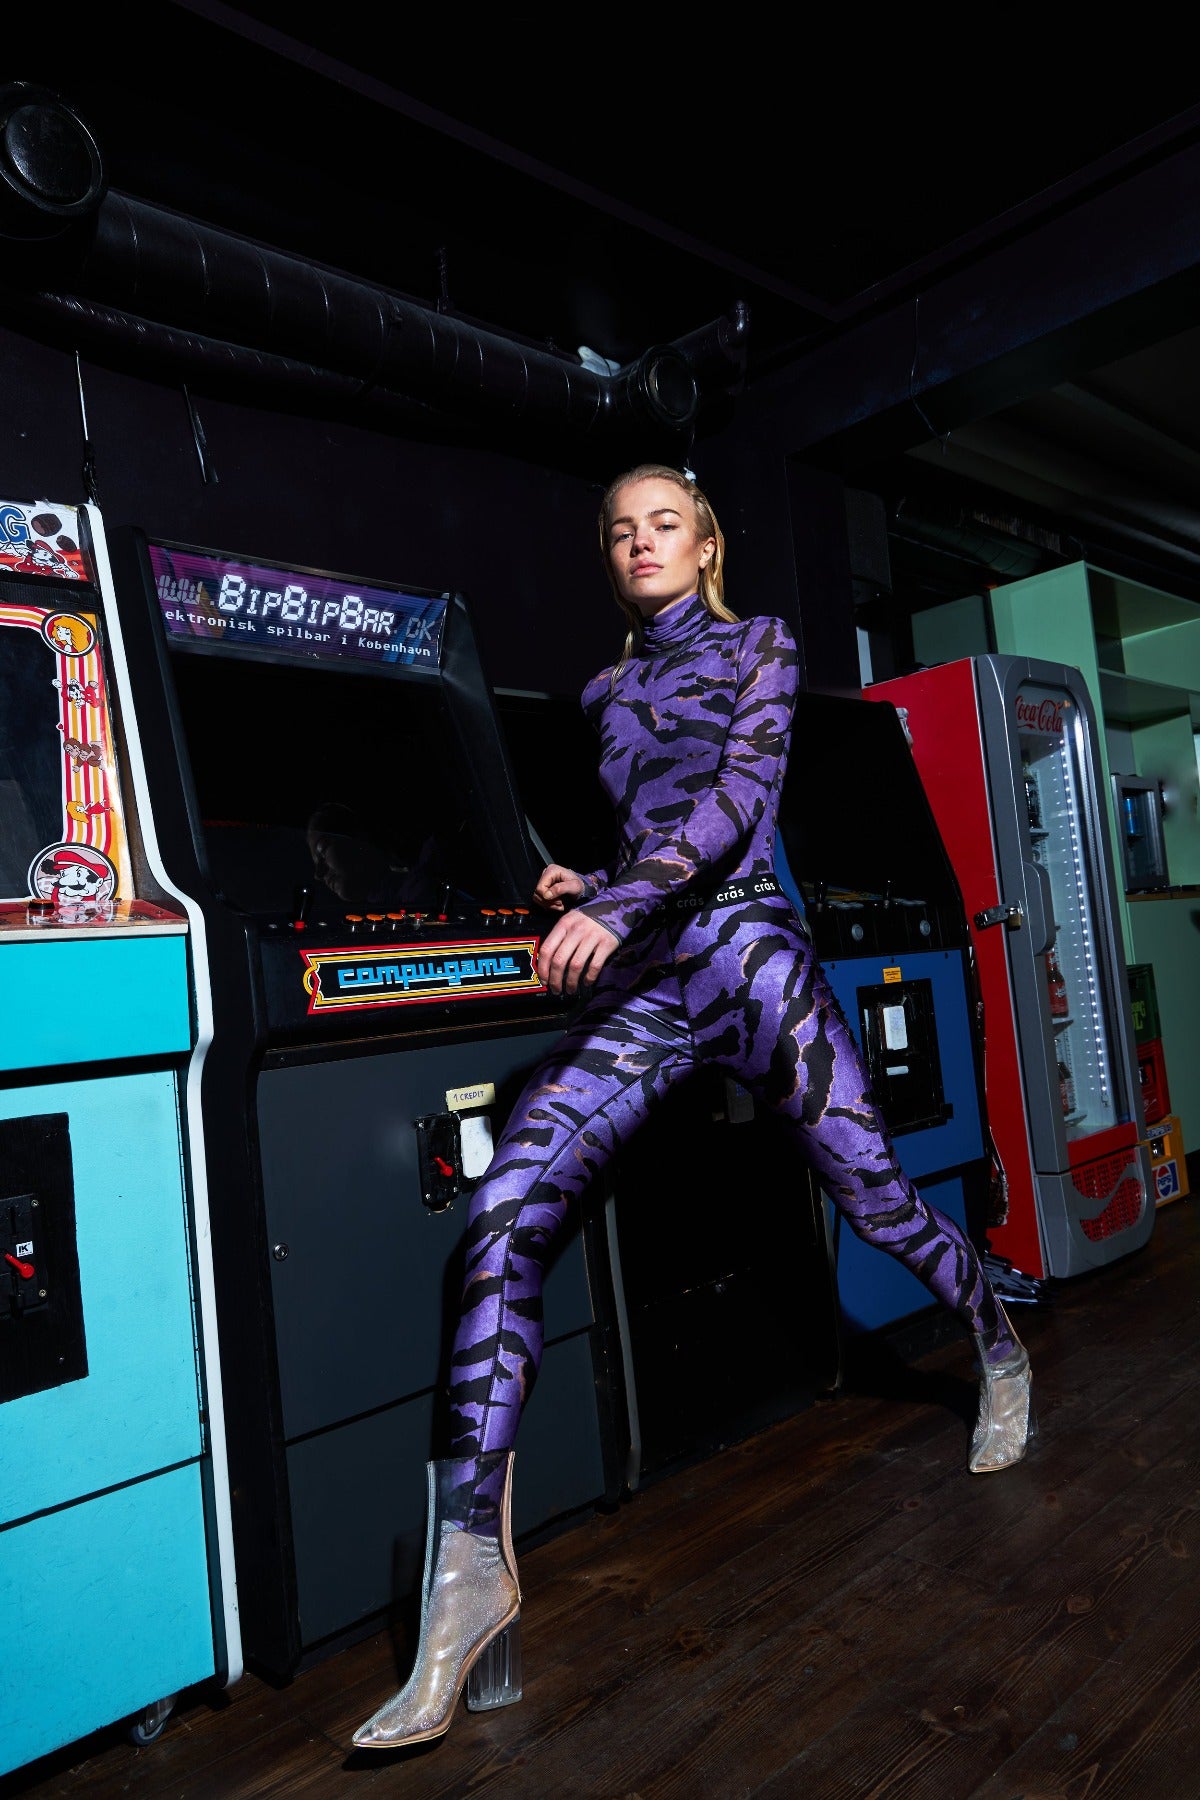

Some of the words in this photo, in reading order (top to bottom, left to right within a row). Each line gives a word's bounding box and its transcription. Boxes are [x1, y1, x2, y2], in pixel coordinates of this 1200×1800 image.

[165, 610, 256, 631] ektronisk
[267, 625, 331, 642] spilbar
[341, 635, 348, 645] i
[358, 637, 431, 657] København
[460, 1090, 485, 1101] CREDIT
